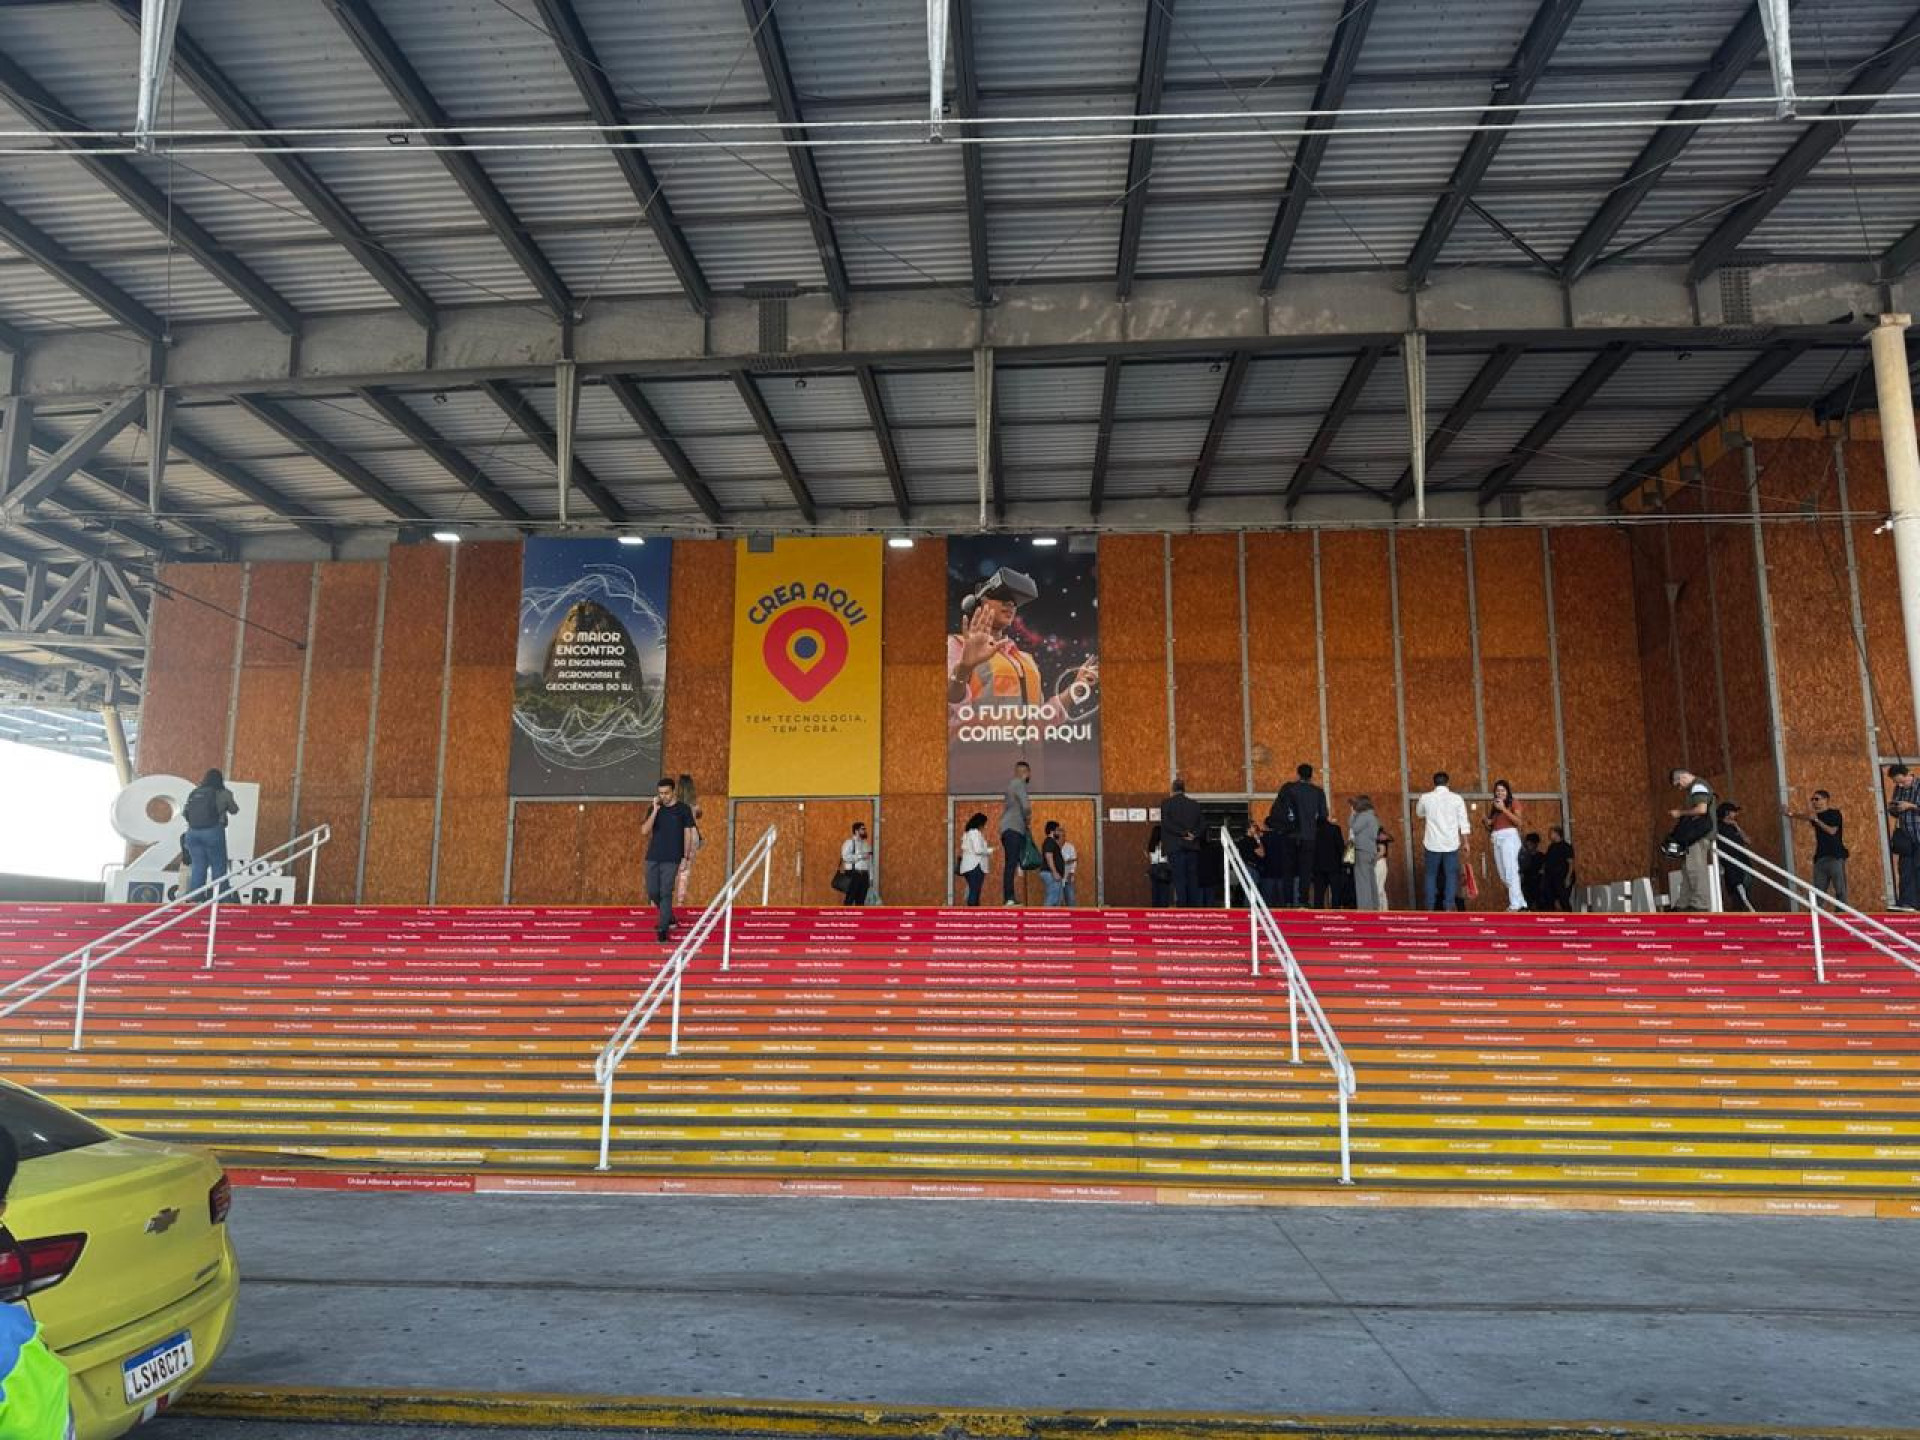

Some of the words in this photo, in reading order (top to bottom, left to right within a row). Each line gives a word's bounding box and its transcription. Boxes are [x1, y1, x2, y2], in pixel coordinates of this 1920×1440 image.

[749, 582, 805, 624] CREA
[813, 582, 867, 626] AQUI
[563, 632, 573, 642] O
[577, 632, 621, 642] MAIOR
[556, 646, 625, 655] ENCONTRO
[568, 659, 626, 668] ENGENHARIA,
[558, 671, 612, 679] AGRONOMIA
[615, 671, 620, 679] E
[546, 682, 604, 690] GEOCIÊNCIAS
[959, 705, 974, 720] O
[979, 704, 1056, 720] FUTURO
[746, 715, 771, 723] TEM
[779, 714, 866, 723] TECNOLOGIA,
[959, 725, 1039, 744] COMEÇA
[1045, 724, 1092, 743] AQUI
